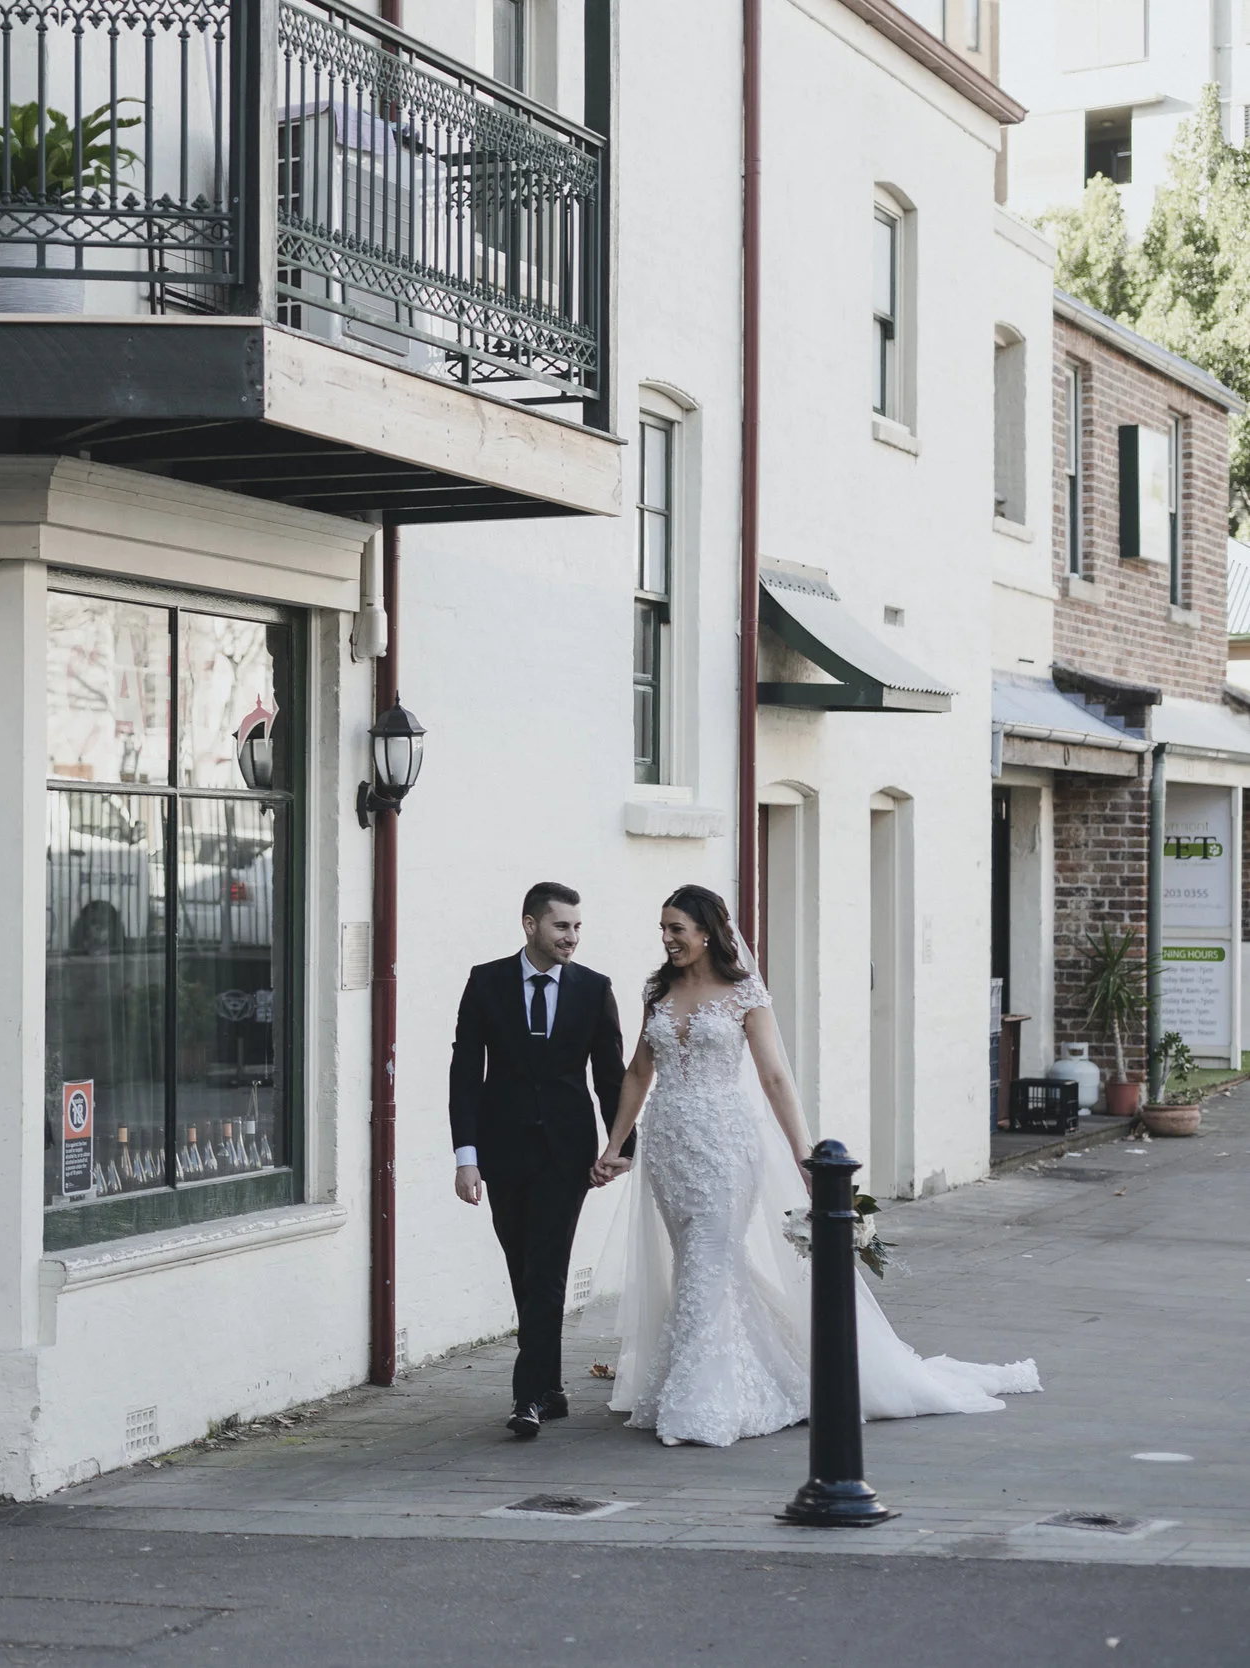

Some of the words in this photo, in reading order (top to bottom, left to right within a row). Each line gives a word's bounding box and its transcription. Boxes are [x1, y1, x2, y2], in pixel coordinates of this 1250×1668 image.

[1165, 821, 1209, 832] yrmont
[1163, 888, 1181, 898] 203
[1184, 888, 1209, 898] 0355
[1163, 950, 1187, 959] NING
[1188, 950, 1219, 959] HOURS
